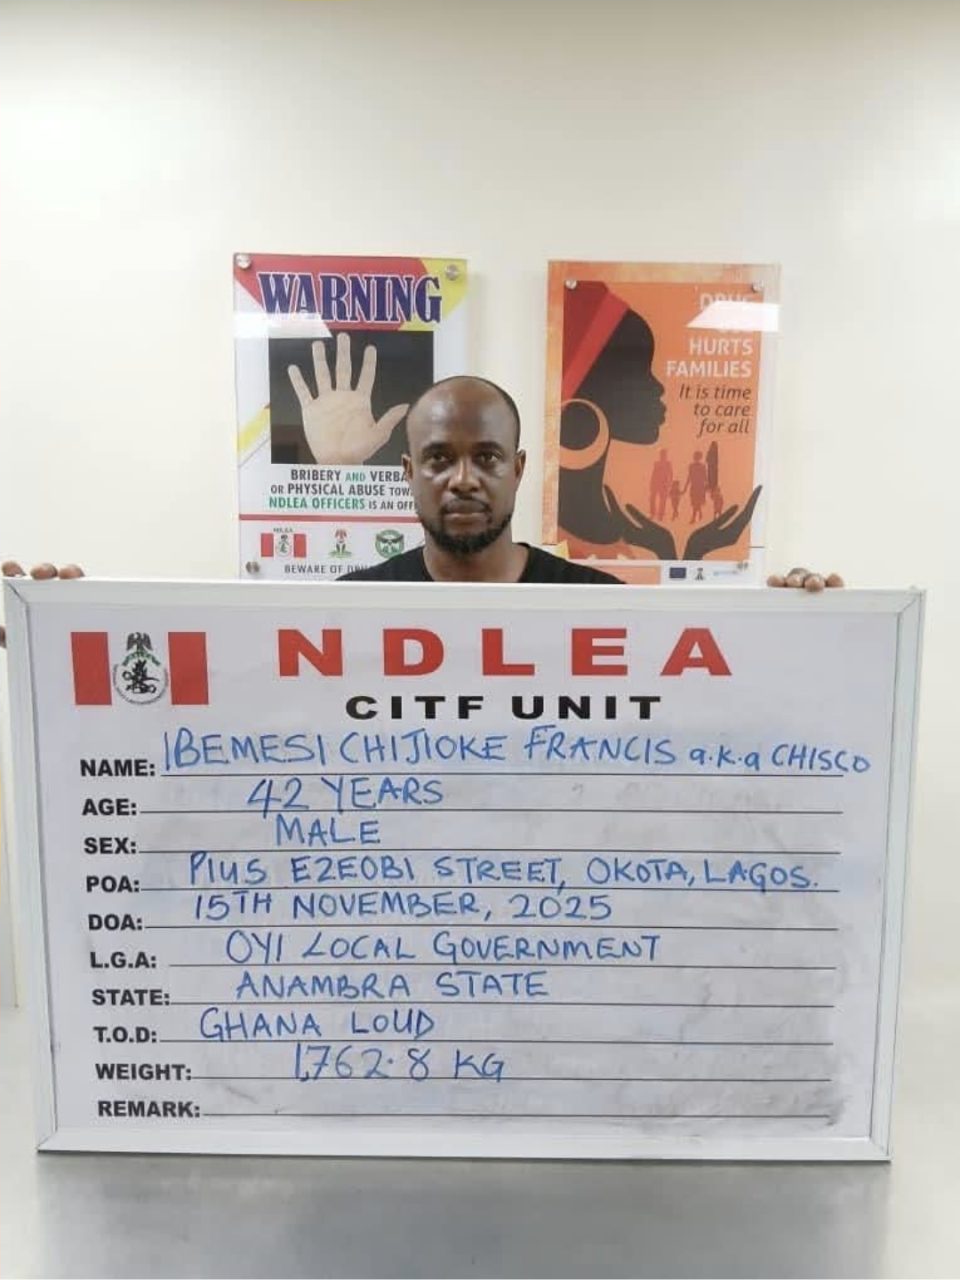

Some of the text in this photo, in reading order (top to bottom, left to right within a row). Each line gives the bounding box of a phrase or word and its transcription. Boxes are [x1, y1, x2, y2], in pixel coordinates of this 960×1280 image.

[256, 272, 443, 324] WARNING
[689, 338, 754, 356] HURTS
[666, 360, 753, 378] FAMILIES
[679, 383, 752, 400] It is time
[694, 402, 751, 417] to care
[697, 417, 750, 439] for all
[290, 468, 341, 482] BRIBERY
[344, 471, 366, 482] AND
[270, 483, 413, 496] OR PHYSICAL ABUSE TOW
[268, 496, 308, 510] NDLEA
[311, 497, 365, 510] OFFICERS
[368, 500, 379, 510] IS
[380, 500, 394, 510] AN
[284, 564, 327, 574] BEWARE
[277, 628, 733, 678] NDLEA
[344, 694, 662, 721] CITF UNIT
[80, 758, 156, 778] NAME:
[163, 726, 327, 771] IBEMESI
[339, 727, 508, 766] CHIJIOKE
[523, 724, 677, 765] FRANCIS
[771, 743, 872, 774] CHISCO
[82, 775, 444, 819] AGE: 42 YEARS
[83, 813, 382, 855] SEX: MALE
[86, 875, 141, 894] POA:
[88, 889, 613, 932] DOA: 15TH NOVEMBER, 2025
[90, 929, 661, 969] L.G.A: OYI LOCAL GOVERNMENT
[91, 970, 551, 1007] STATE: ANAMBRA STATE
[93, 1006, 436, 1044] T.O.D: GHANA LOUD
[95, 1063, 193, 1081] WEIGHT:
[454, 1048, 506, 1083] KG
[97, 1100, 201, 1119] REMARK:
